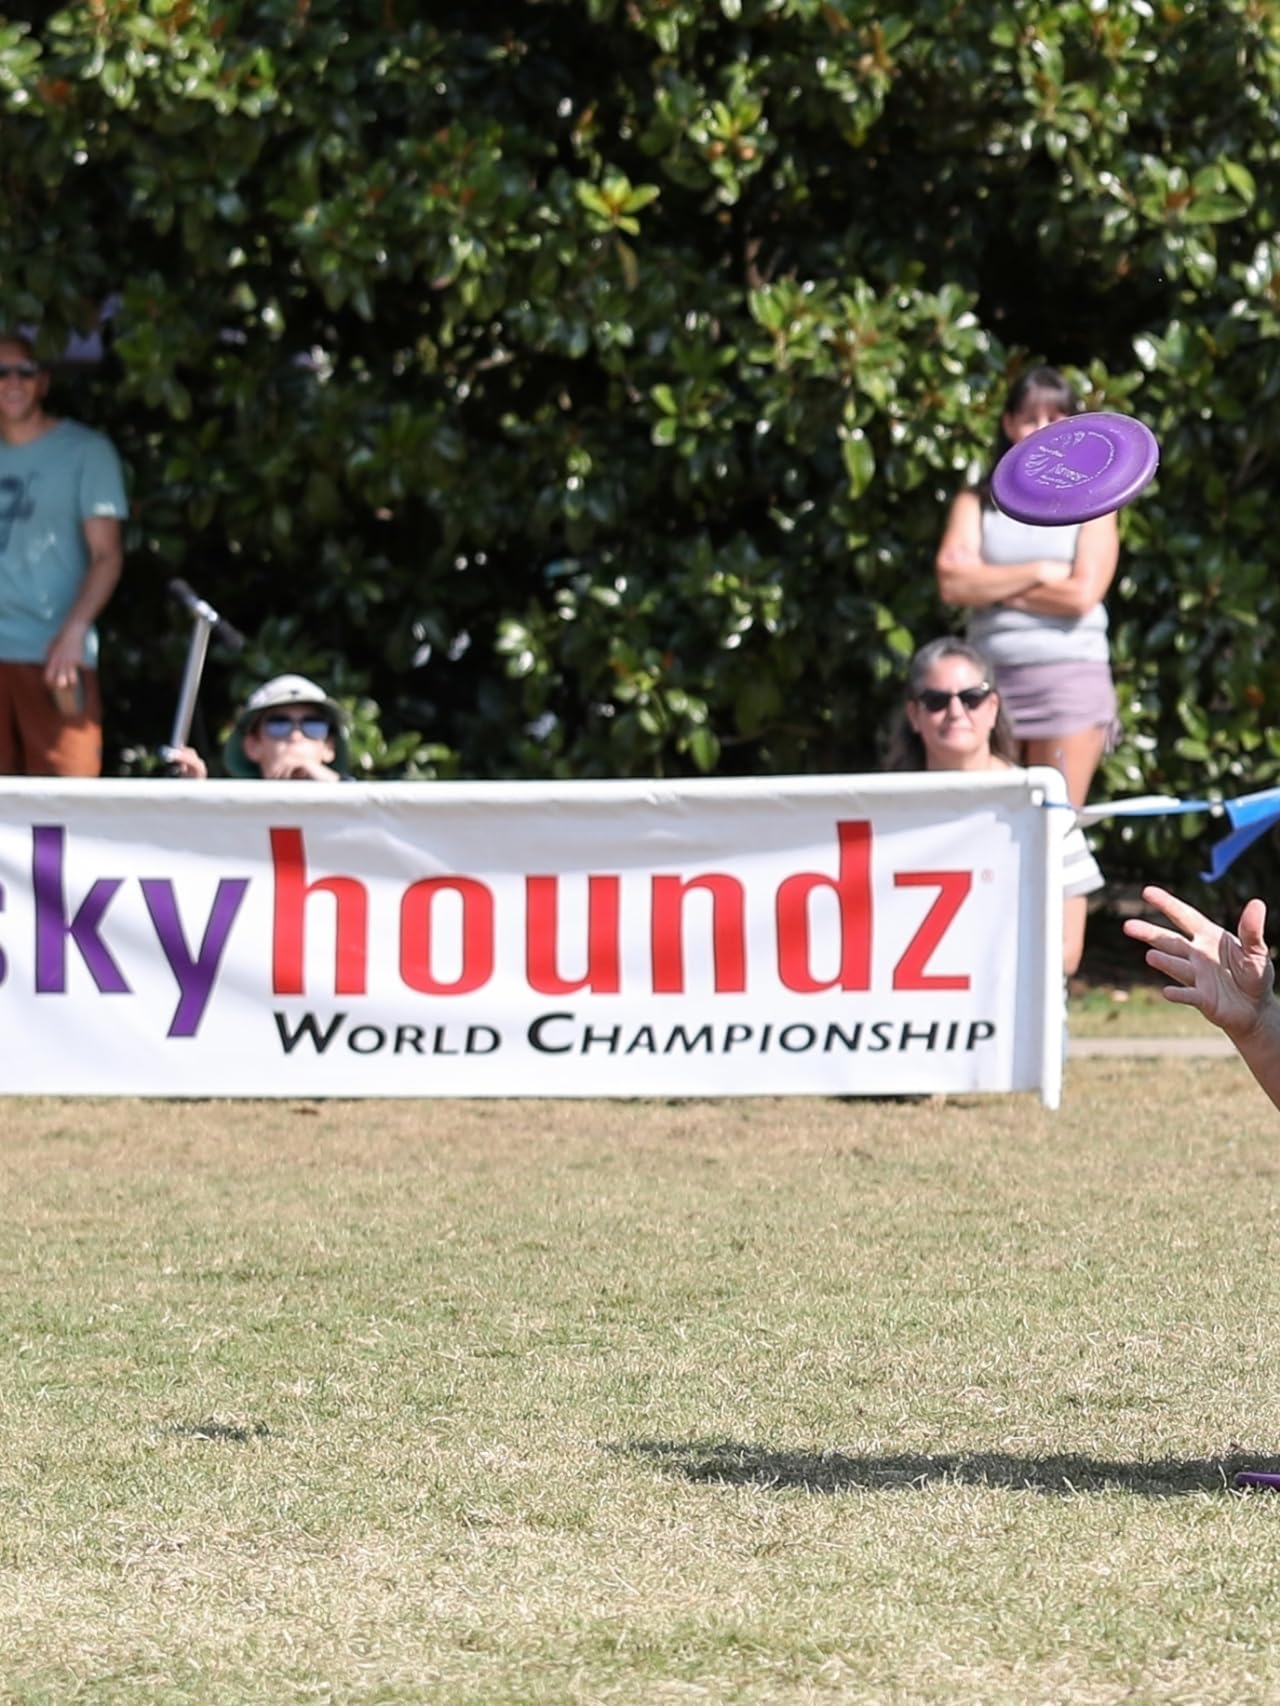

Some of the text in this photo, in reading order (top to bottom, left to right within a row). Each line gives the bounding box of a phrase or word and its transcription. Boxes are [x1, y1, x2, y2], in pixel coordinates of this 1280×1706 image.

[0, 820, 973, 1036] kyhoundz
[272, 1012, 996, 1056] WORLD CHAMPIONSHIP
